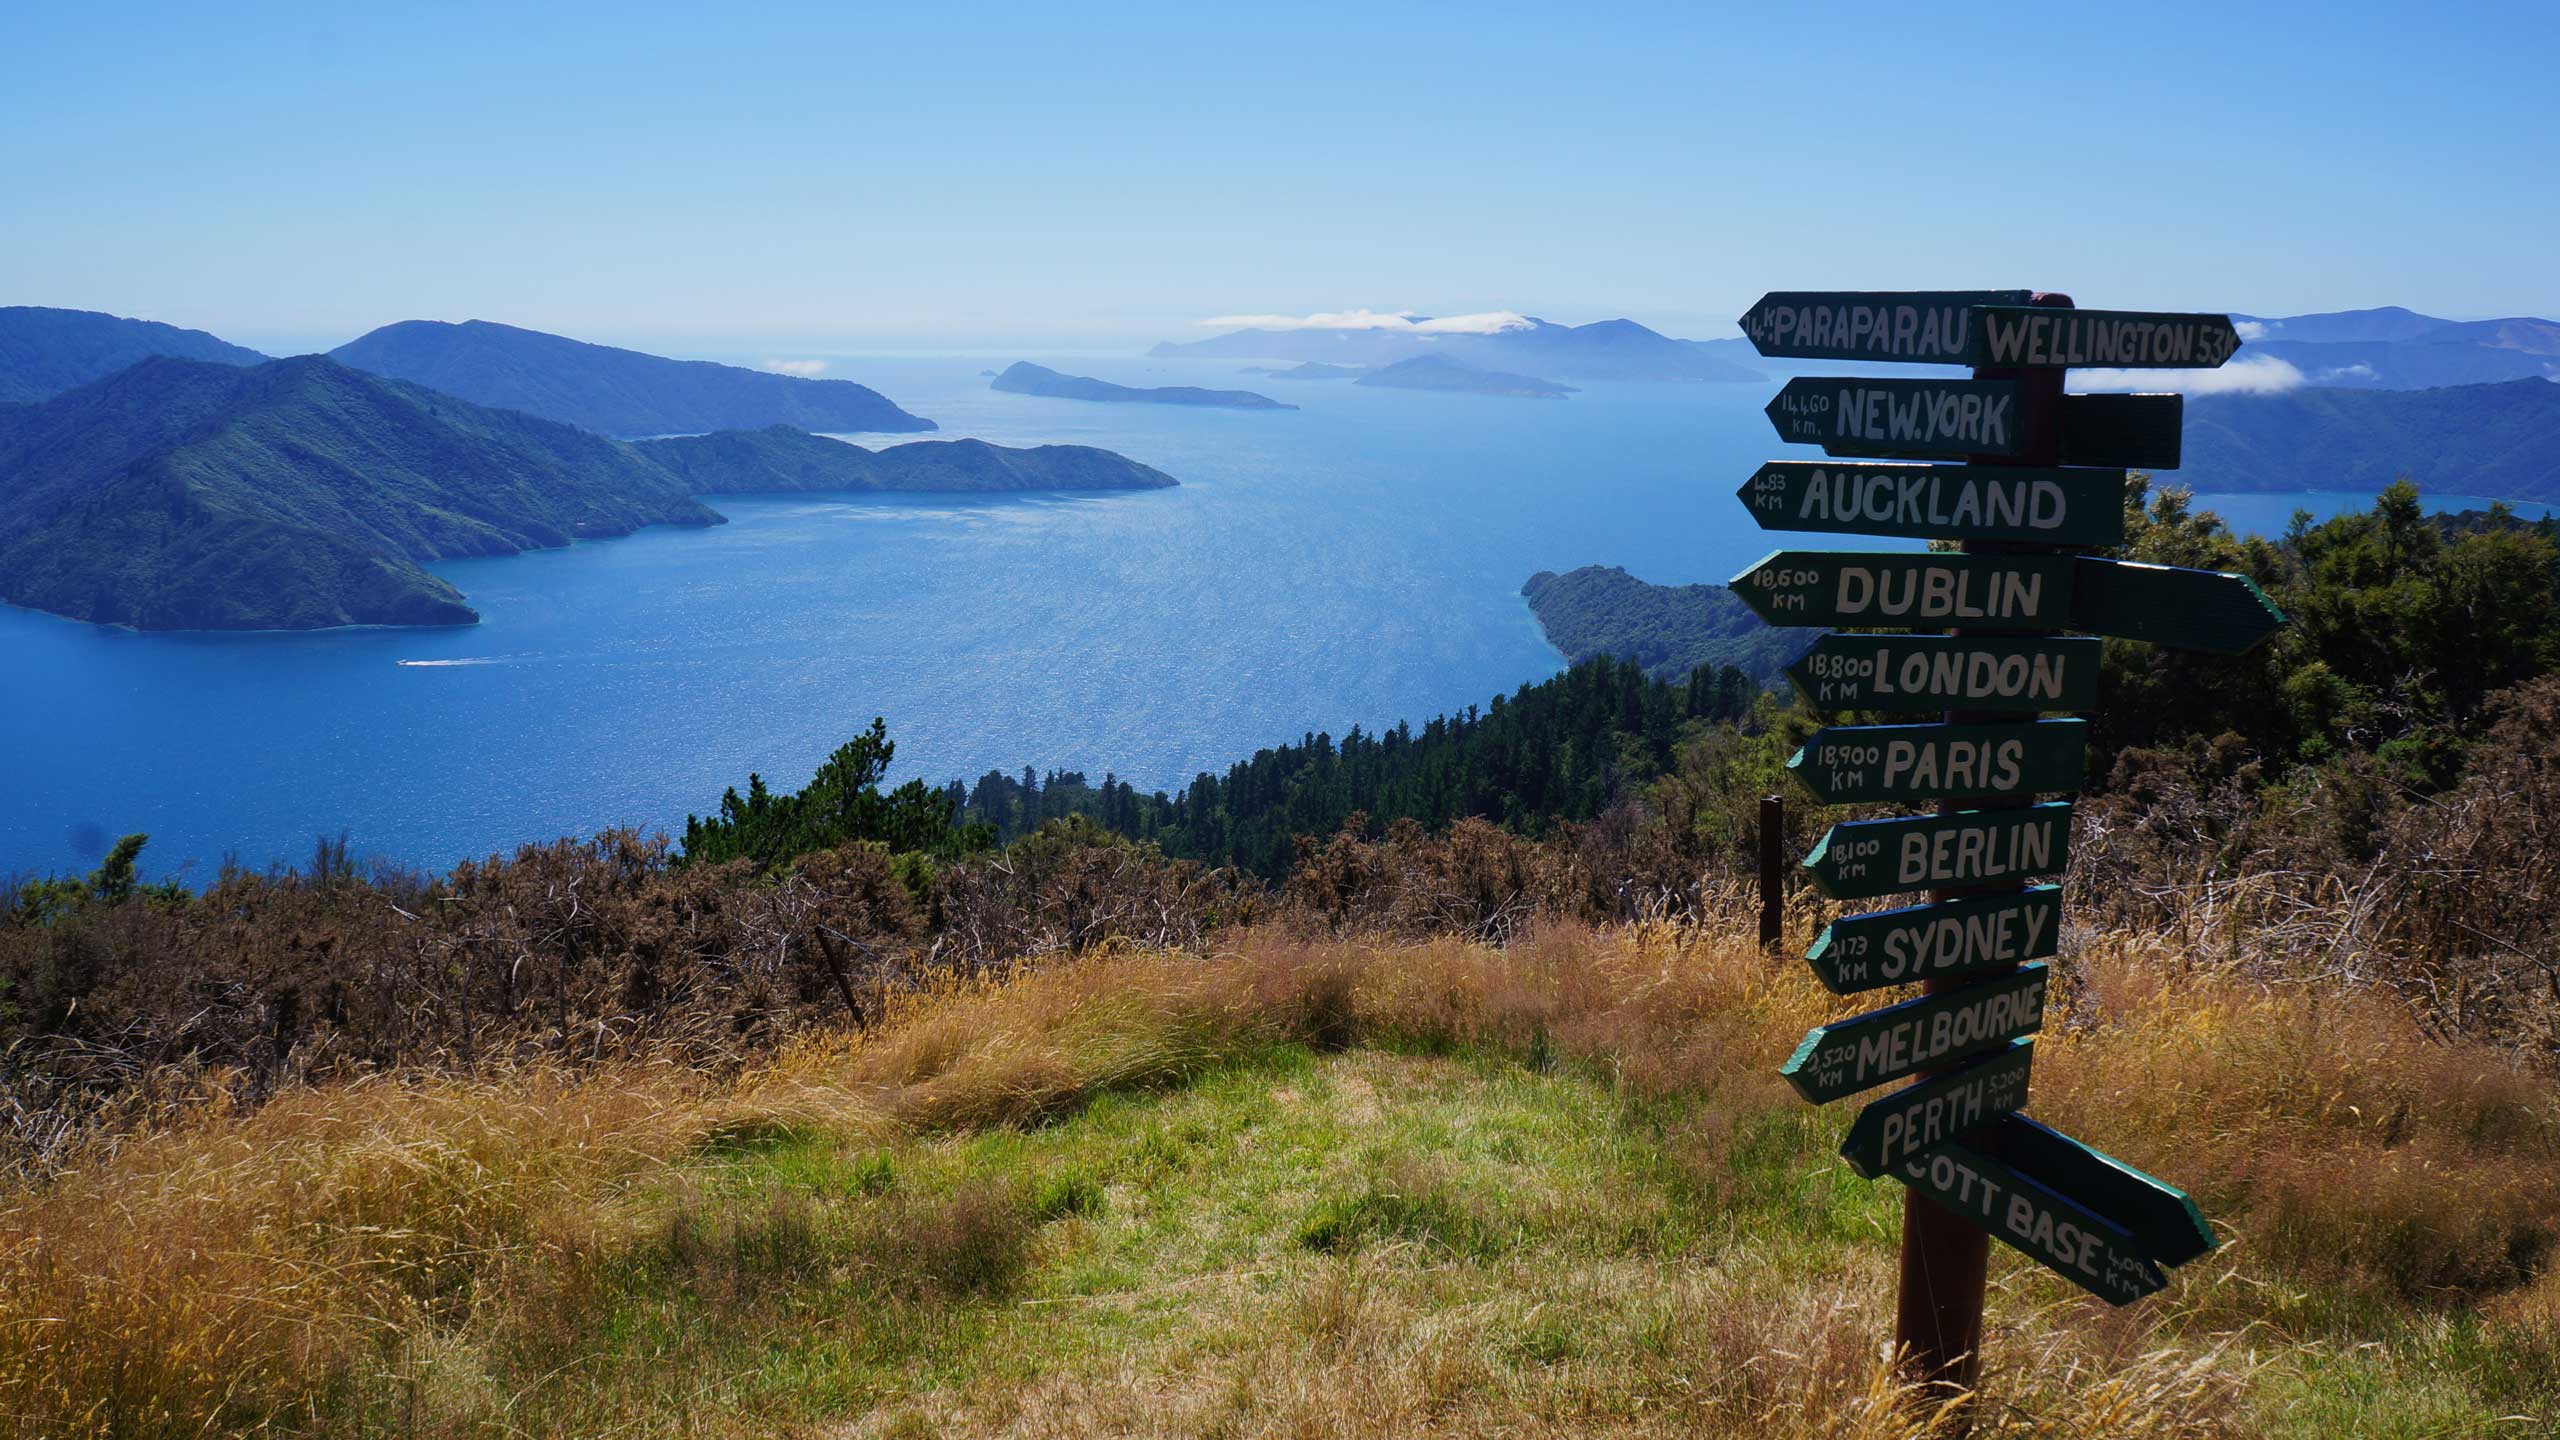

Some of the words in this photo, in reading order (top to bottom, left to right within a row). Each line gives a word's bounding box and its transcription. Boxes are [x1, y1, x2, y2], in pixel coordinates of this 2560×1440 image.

[1986, 313, 2193, 364] WELLINGTON
[1754, 473, 1786, 492] 483
[1755, 492, 1782, 510] KM
[1800, 470, 2066, 529] AUCKLAND
[1772, 592, 1805, 611] KM
[1835, 567, 2041, 617] DUBLIN
[1808, 654, 1873, 679] 18,800
[1873, 649, 2065, 699] LONDON
[1820, 682, 1858, 701] KM
[1817, 745, 1880, 770] 18,900
[1883, 739, 2023, 790] PARIS
[1831, 770, 1863, 792] KM
[1898, 821, 2052, 885] BERLIN
[1838, 863, 1866, 881] KM
[1881, 904, 2049, 980] SYDNEY
[1838, 961, 1868, 984] KM
[1856, 982, 2043, 1082] MELBOURNE
[1818, 1069, 1843, 1088] KM
[1881, 1079, 1983, 1167] PERTH
[2006, 1193, 2105, 1276] BASE
[2106, 1267, 2141, 1299] KM
